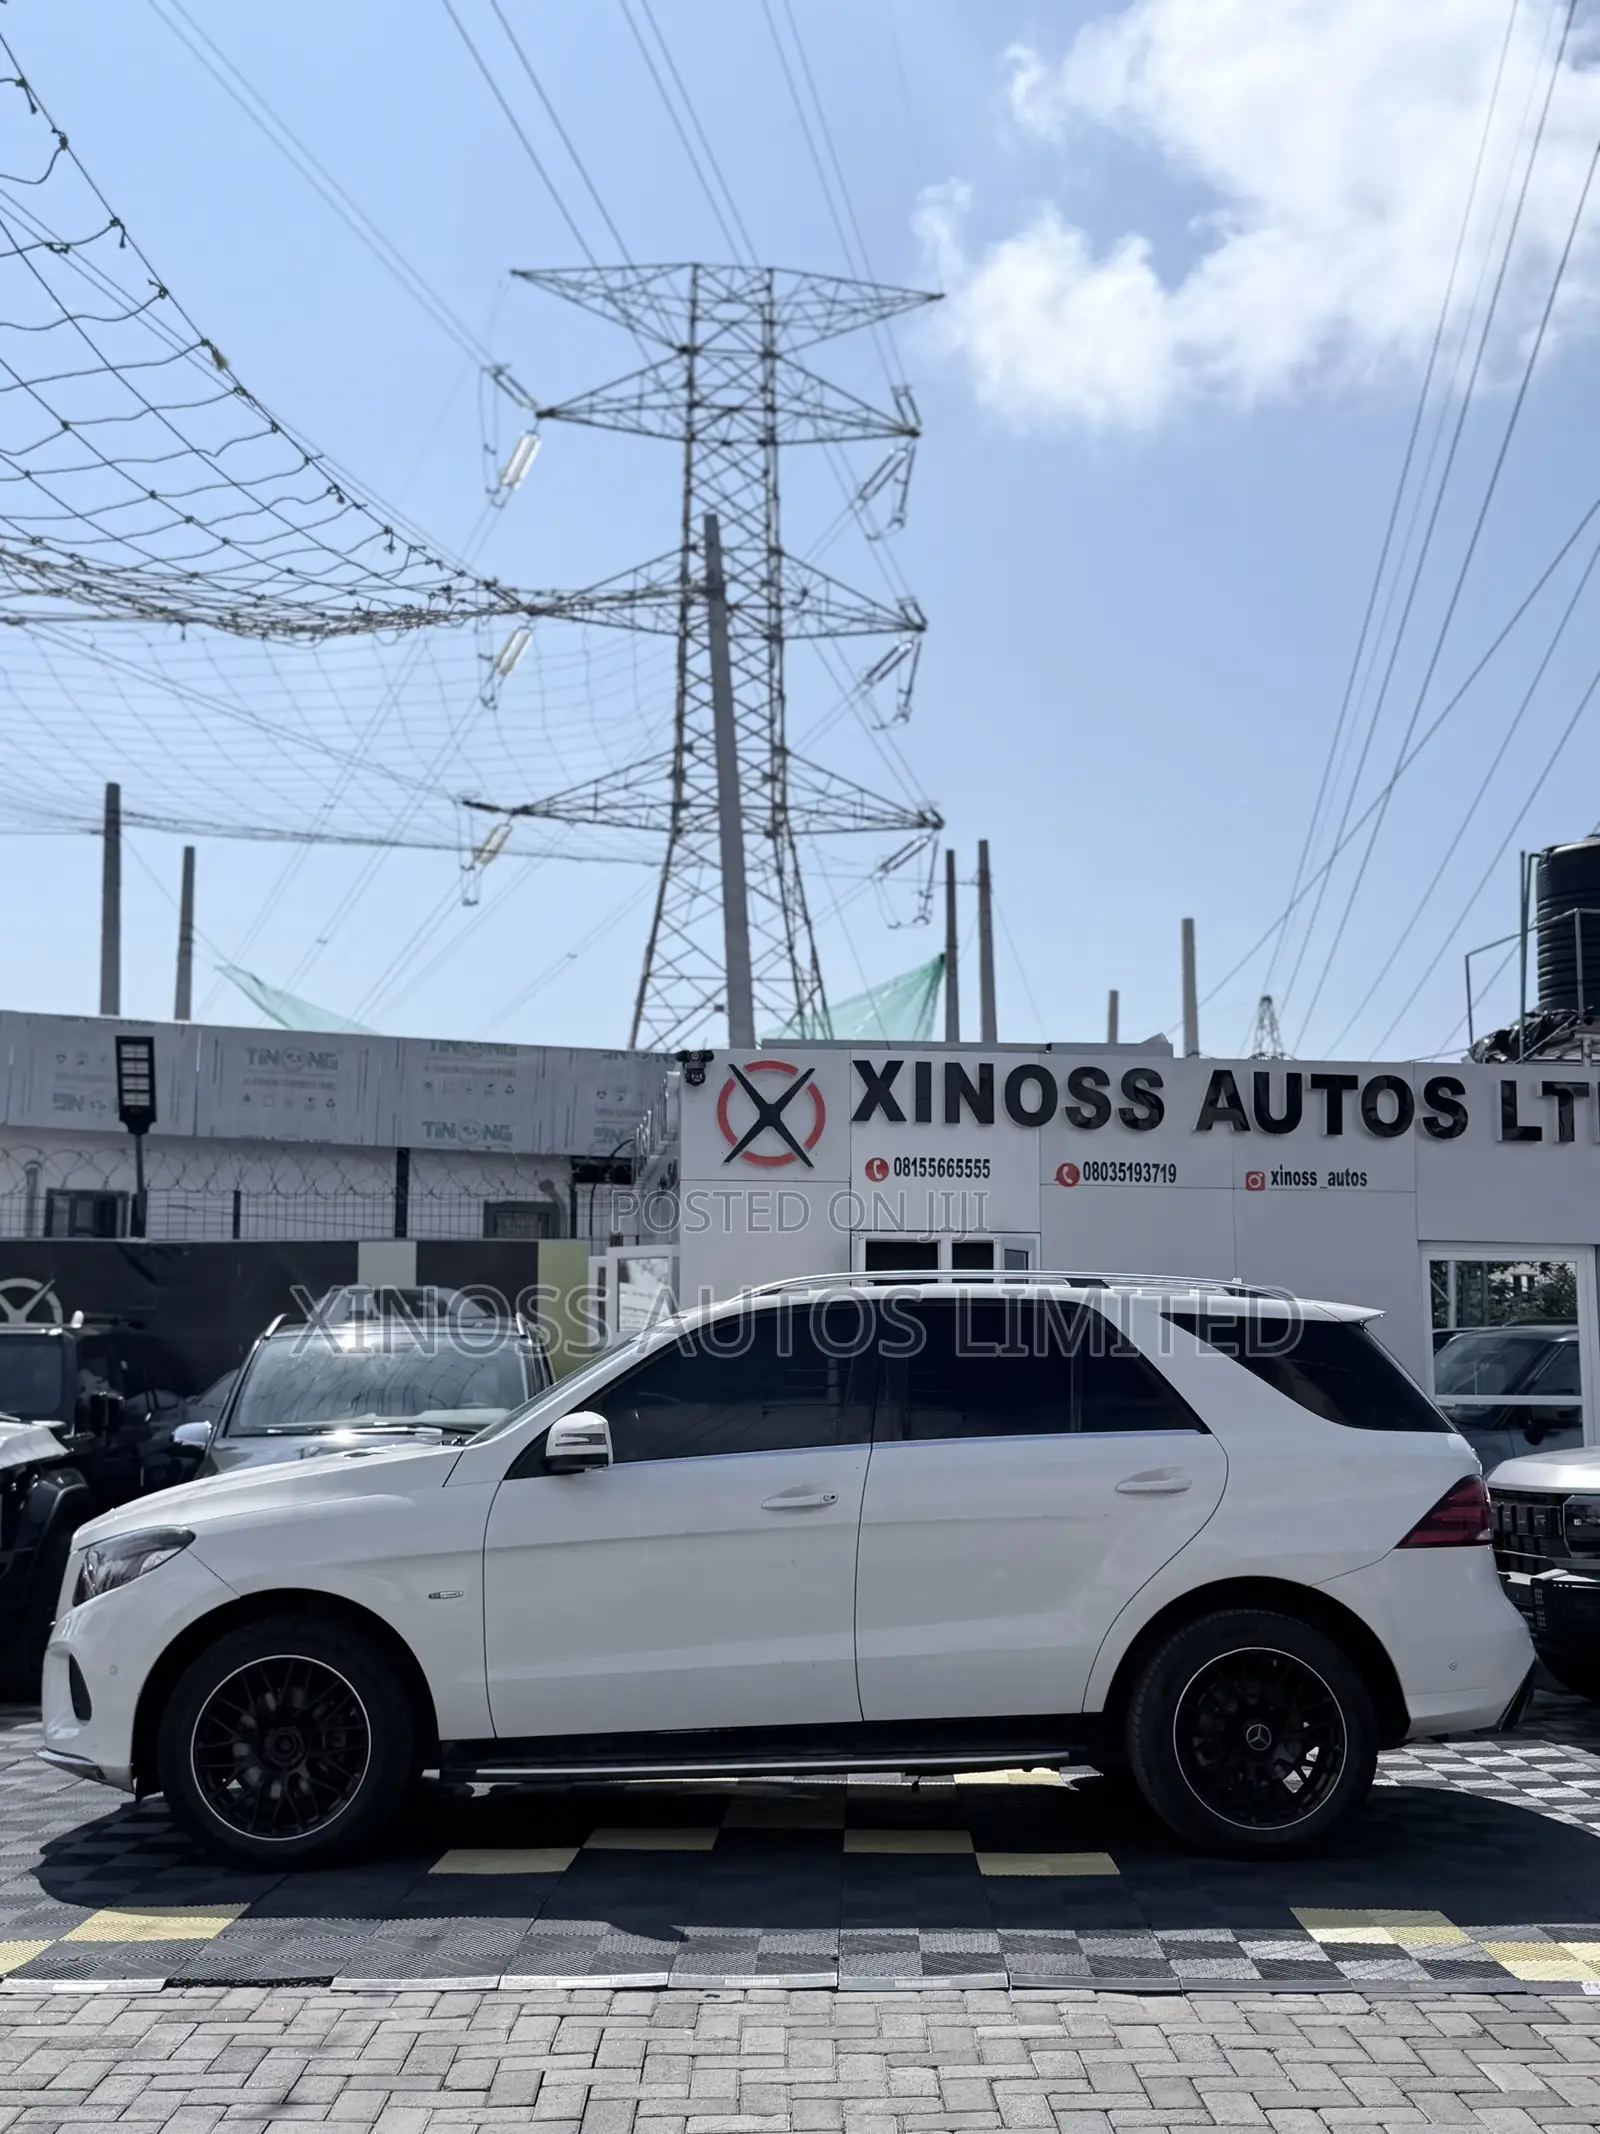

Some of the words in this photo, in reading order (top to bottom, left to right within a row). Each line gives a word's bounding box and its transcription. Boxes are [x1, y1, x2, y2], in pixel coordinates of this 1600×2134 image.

[851, 1060, 1165, 1131] XINOSS
[1195, 1069, 1469, 1140] AUTOS
[1499, 1079, 1600, 1142] LT
[893, 1156, 991, 1178] 08155665555
[1082, 1161, 1177, 1183] 08035193719
